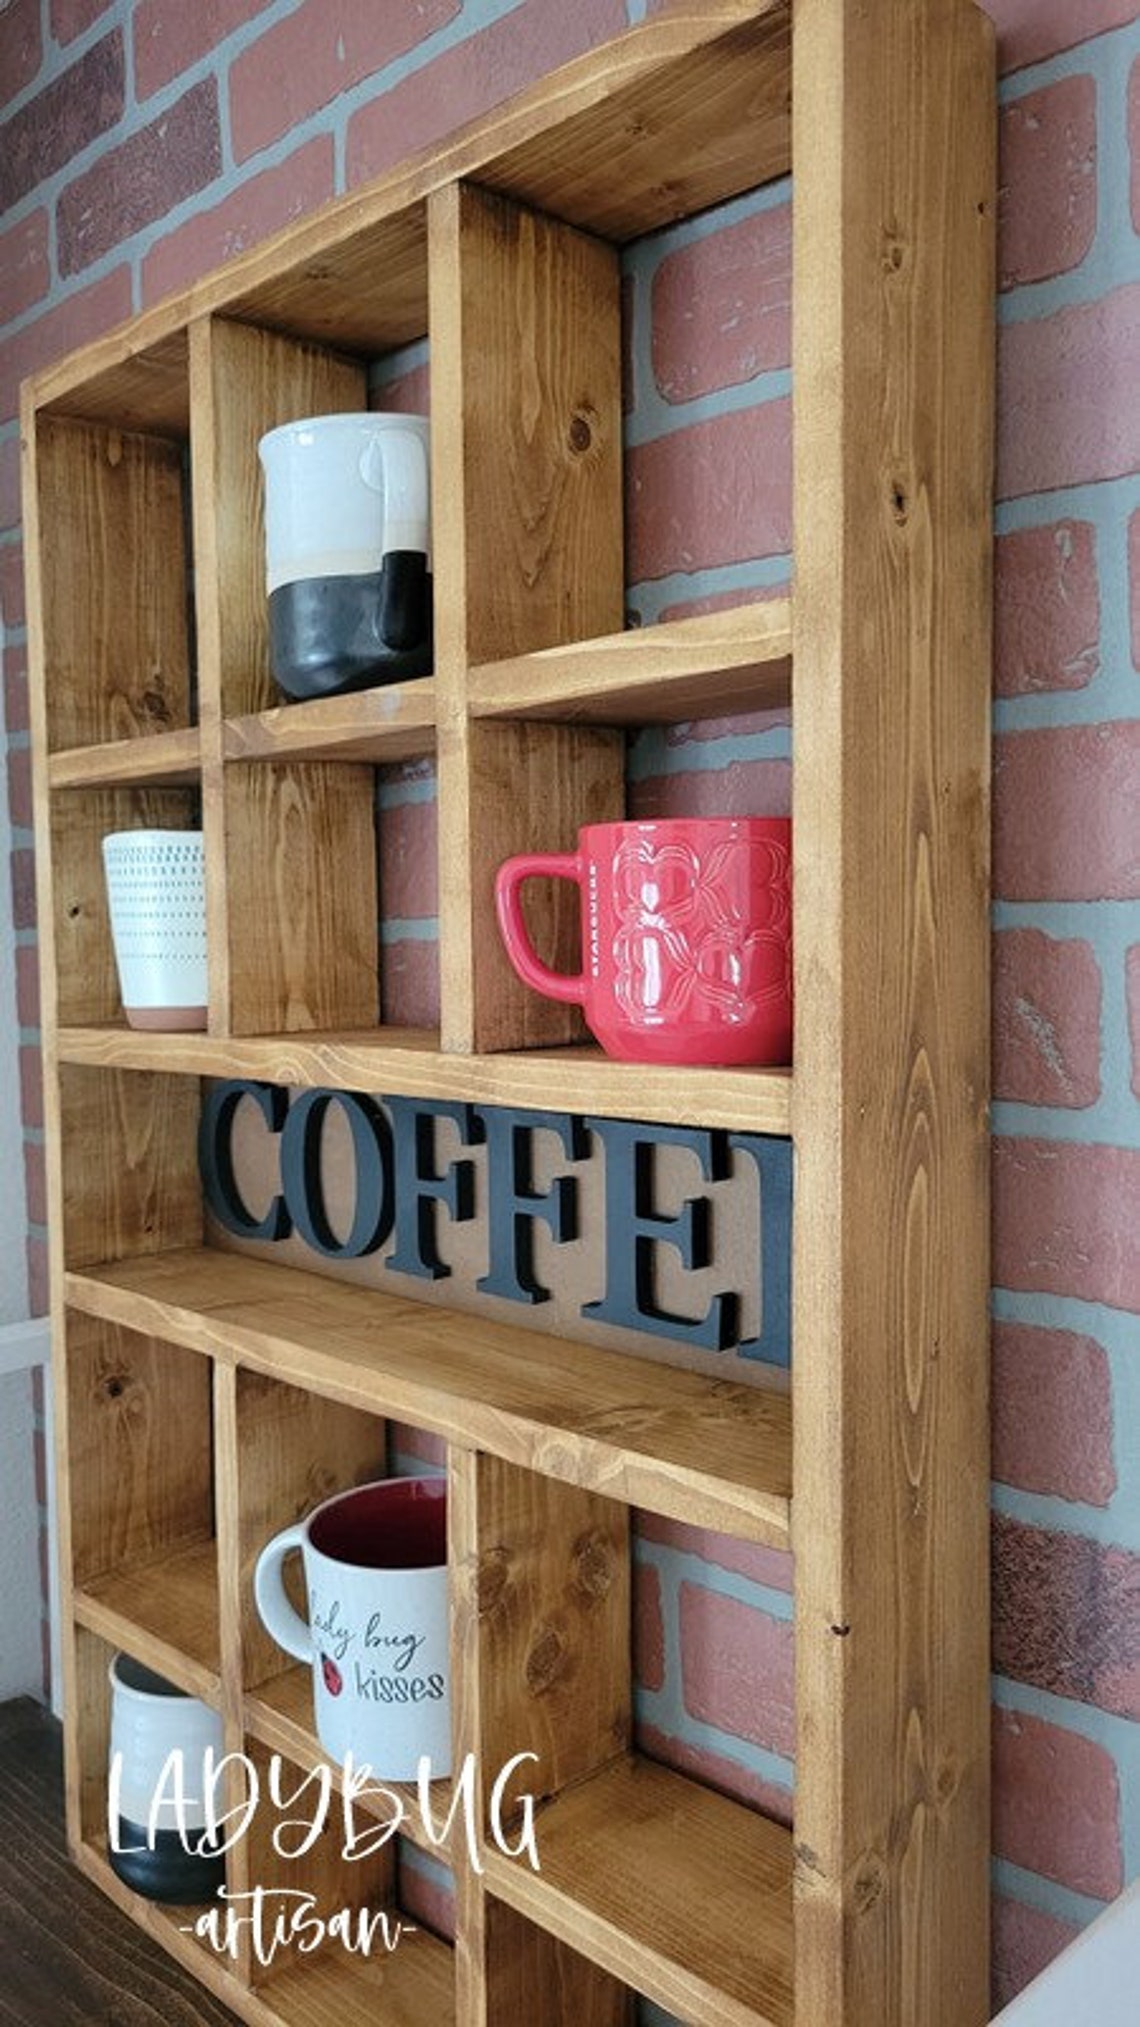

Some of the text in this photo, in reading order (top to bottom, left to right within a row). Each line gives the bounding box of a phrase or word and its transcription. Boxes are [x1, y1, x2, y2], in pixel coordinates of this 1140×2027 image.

[588, 865, 600, 977] STARBUCKS
[364, 1611, 427, 1673] bug
[354, 1661, 445, 1703] kisses
